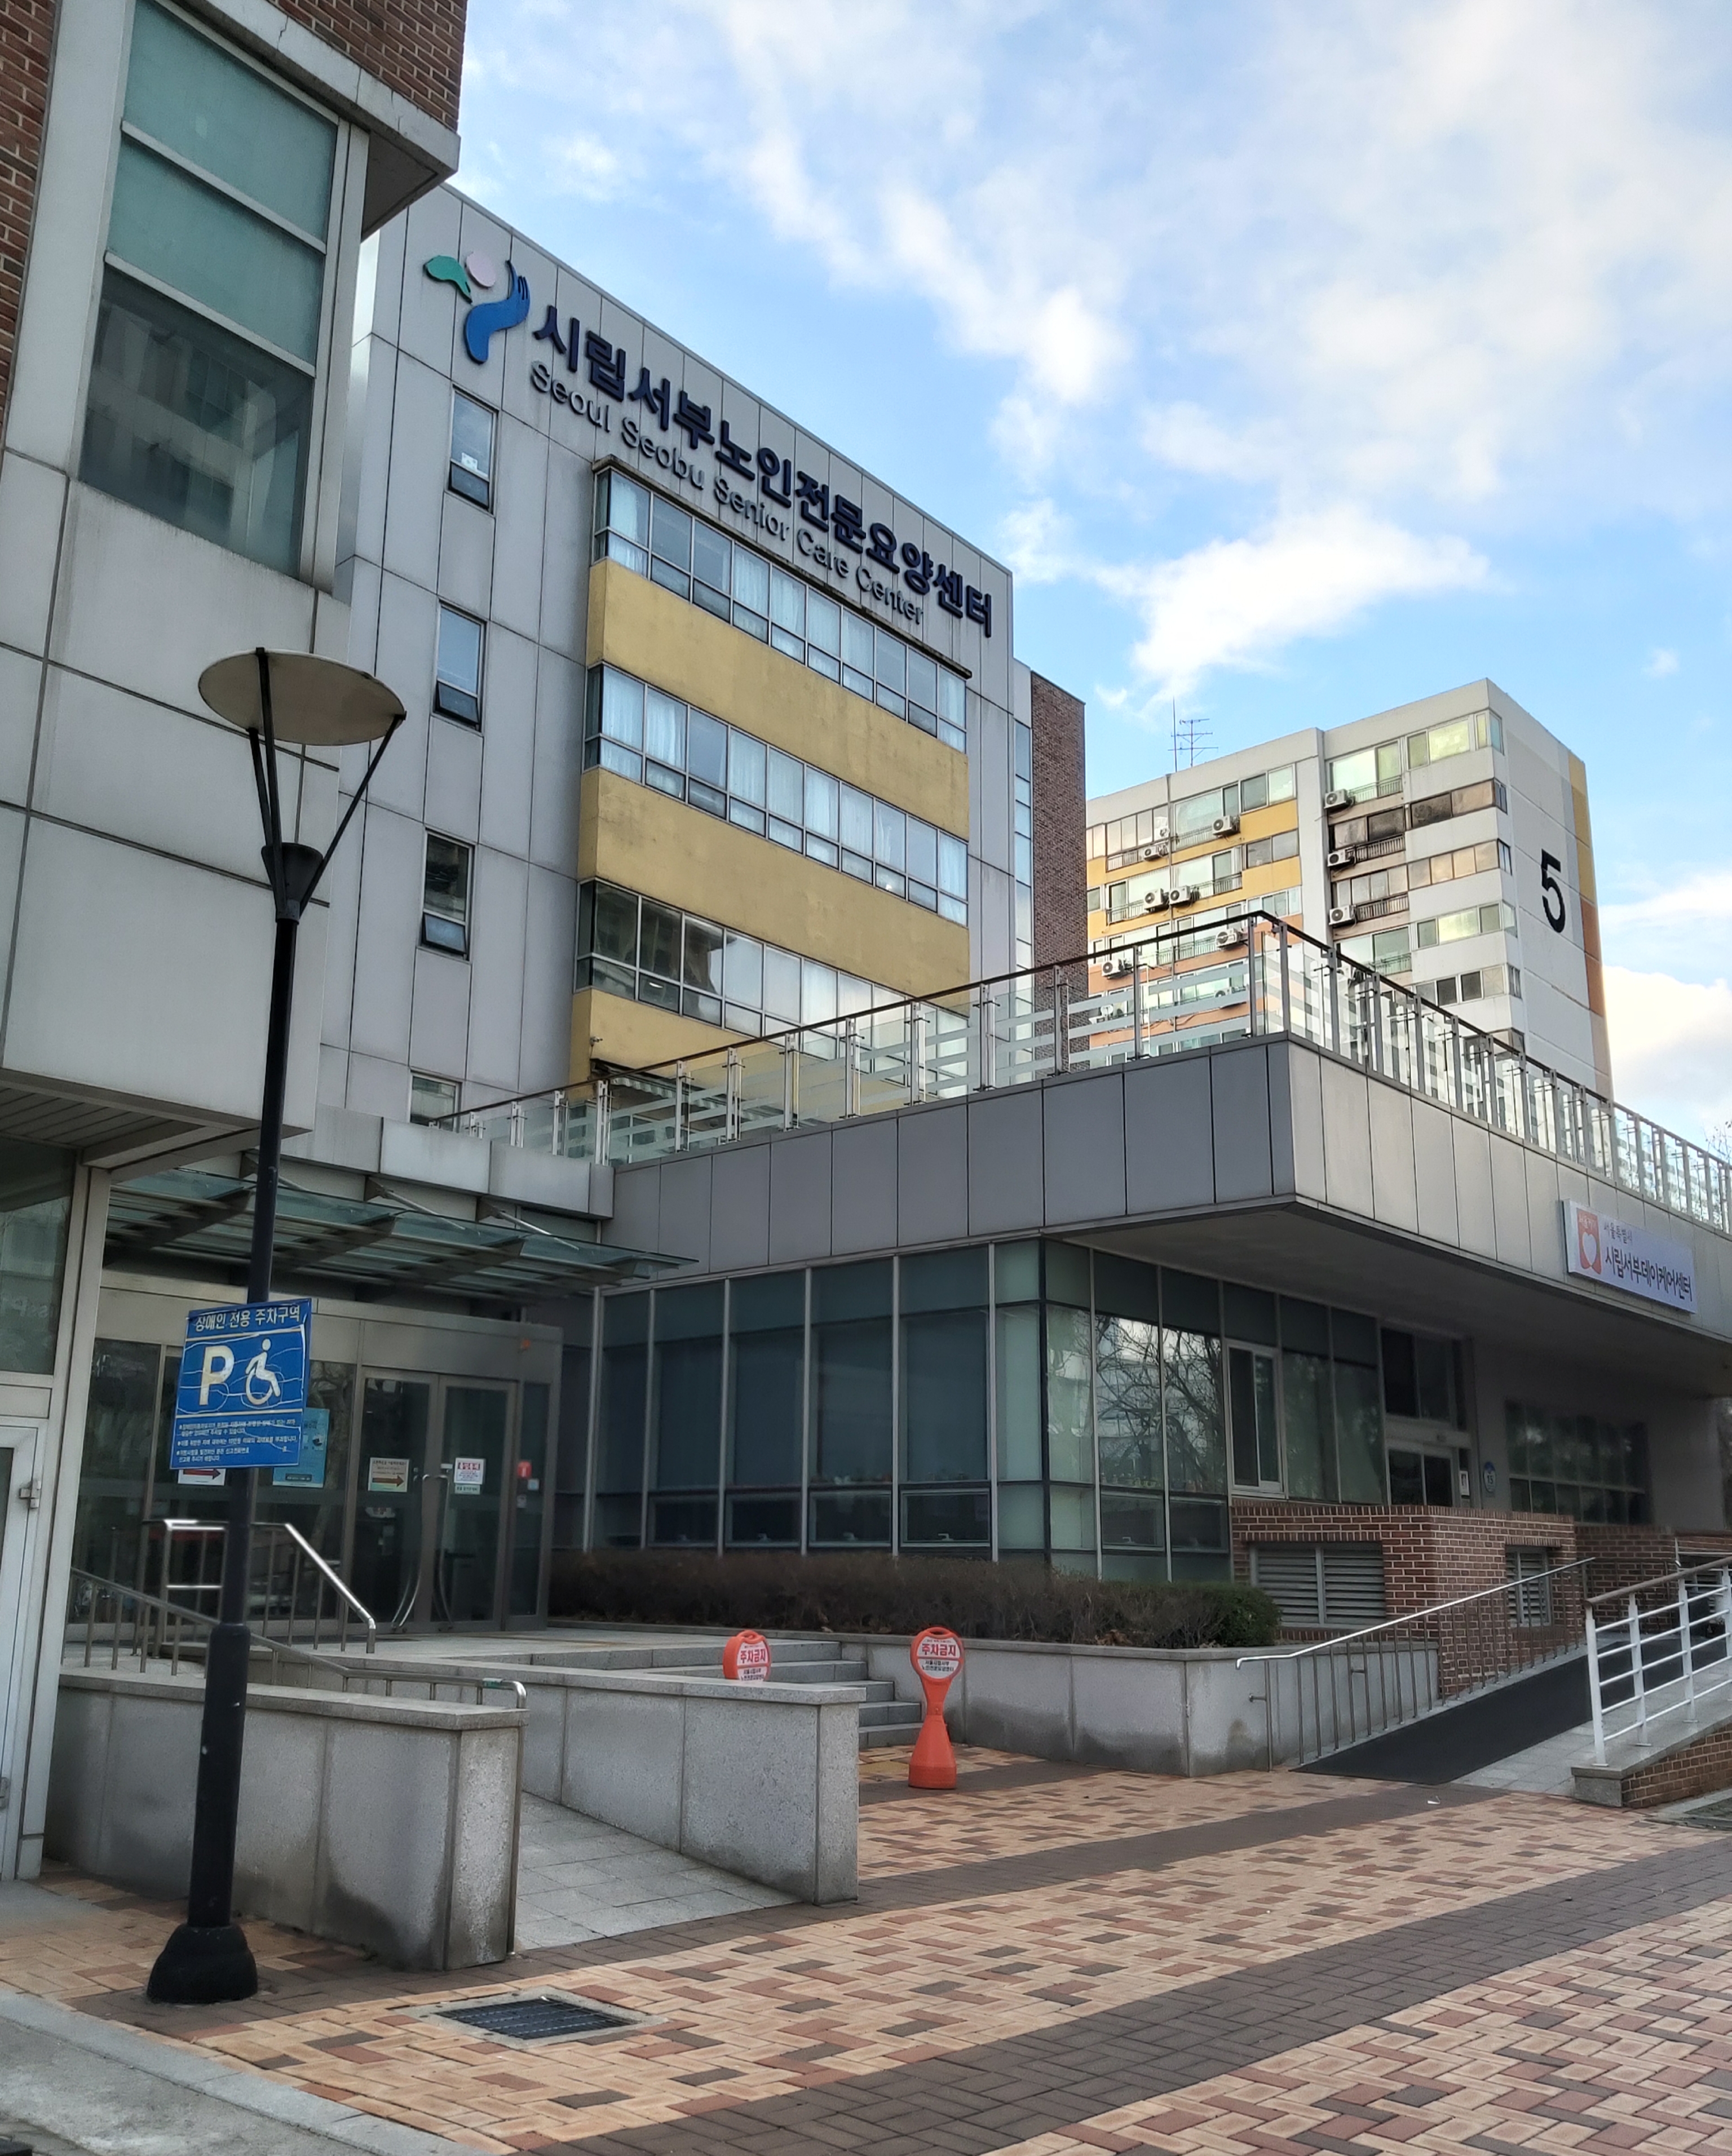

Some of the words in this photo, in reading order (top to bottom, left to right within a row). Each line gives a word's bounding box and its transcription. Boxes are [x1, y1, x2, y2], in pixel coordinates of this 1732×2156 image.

[531, 361, 610, 433] Seoul
[621, 417, 704, 490] Seobu
[714, 475, 790, 541] Senior
[797, 528, 849, 578] Care
[856, 565, 924, 625] Center
[533, 305, 992, 638] 시립서부노인전문요양센터
[1541, 848, 1566, 933] 5
[1605, 1246, 1693, 1301] 시립서부데이케어센터
[196, 1313, 226, 1332] 장애인
[229, 1310, 251, 1328] 전용
[255, 1305, 300, 1325] 주차구역
[200, 1345, 235, 1405] P
[740, 1649, 766, 1664] 주차금지
[922, 1643, 956, 1657] 주차금지
